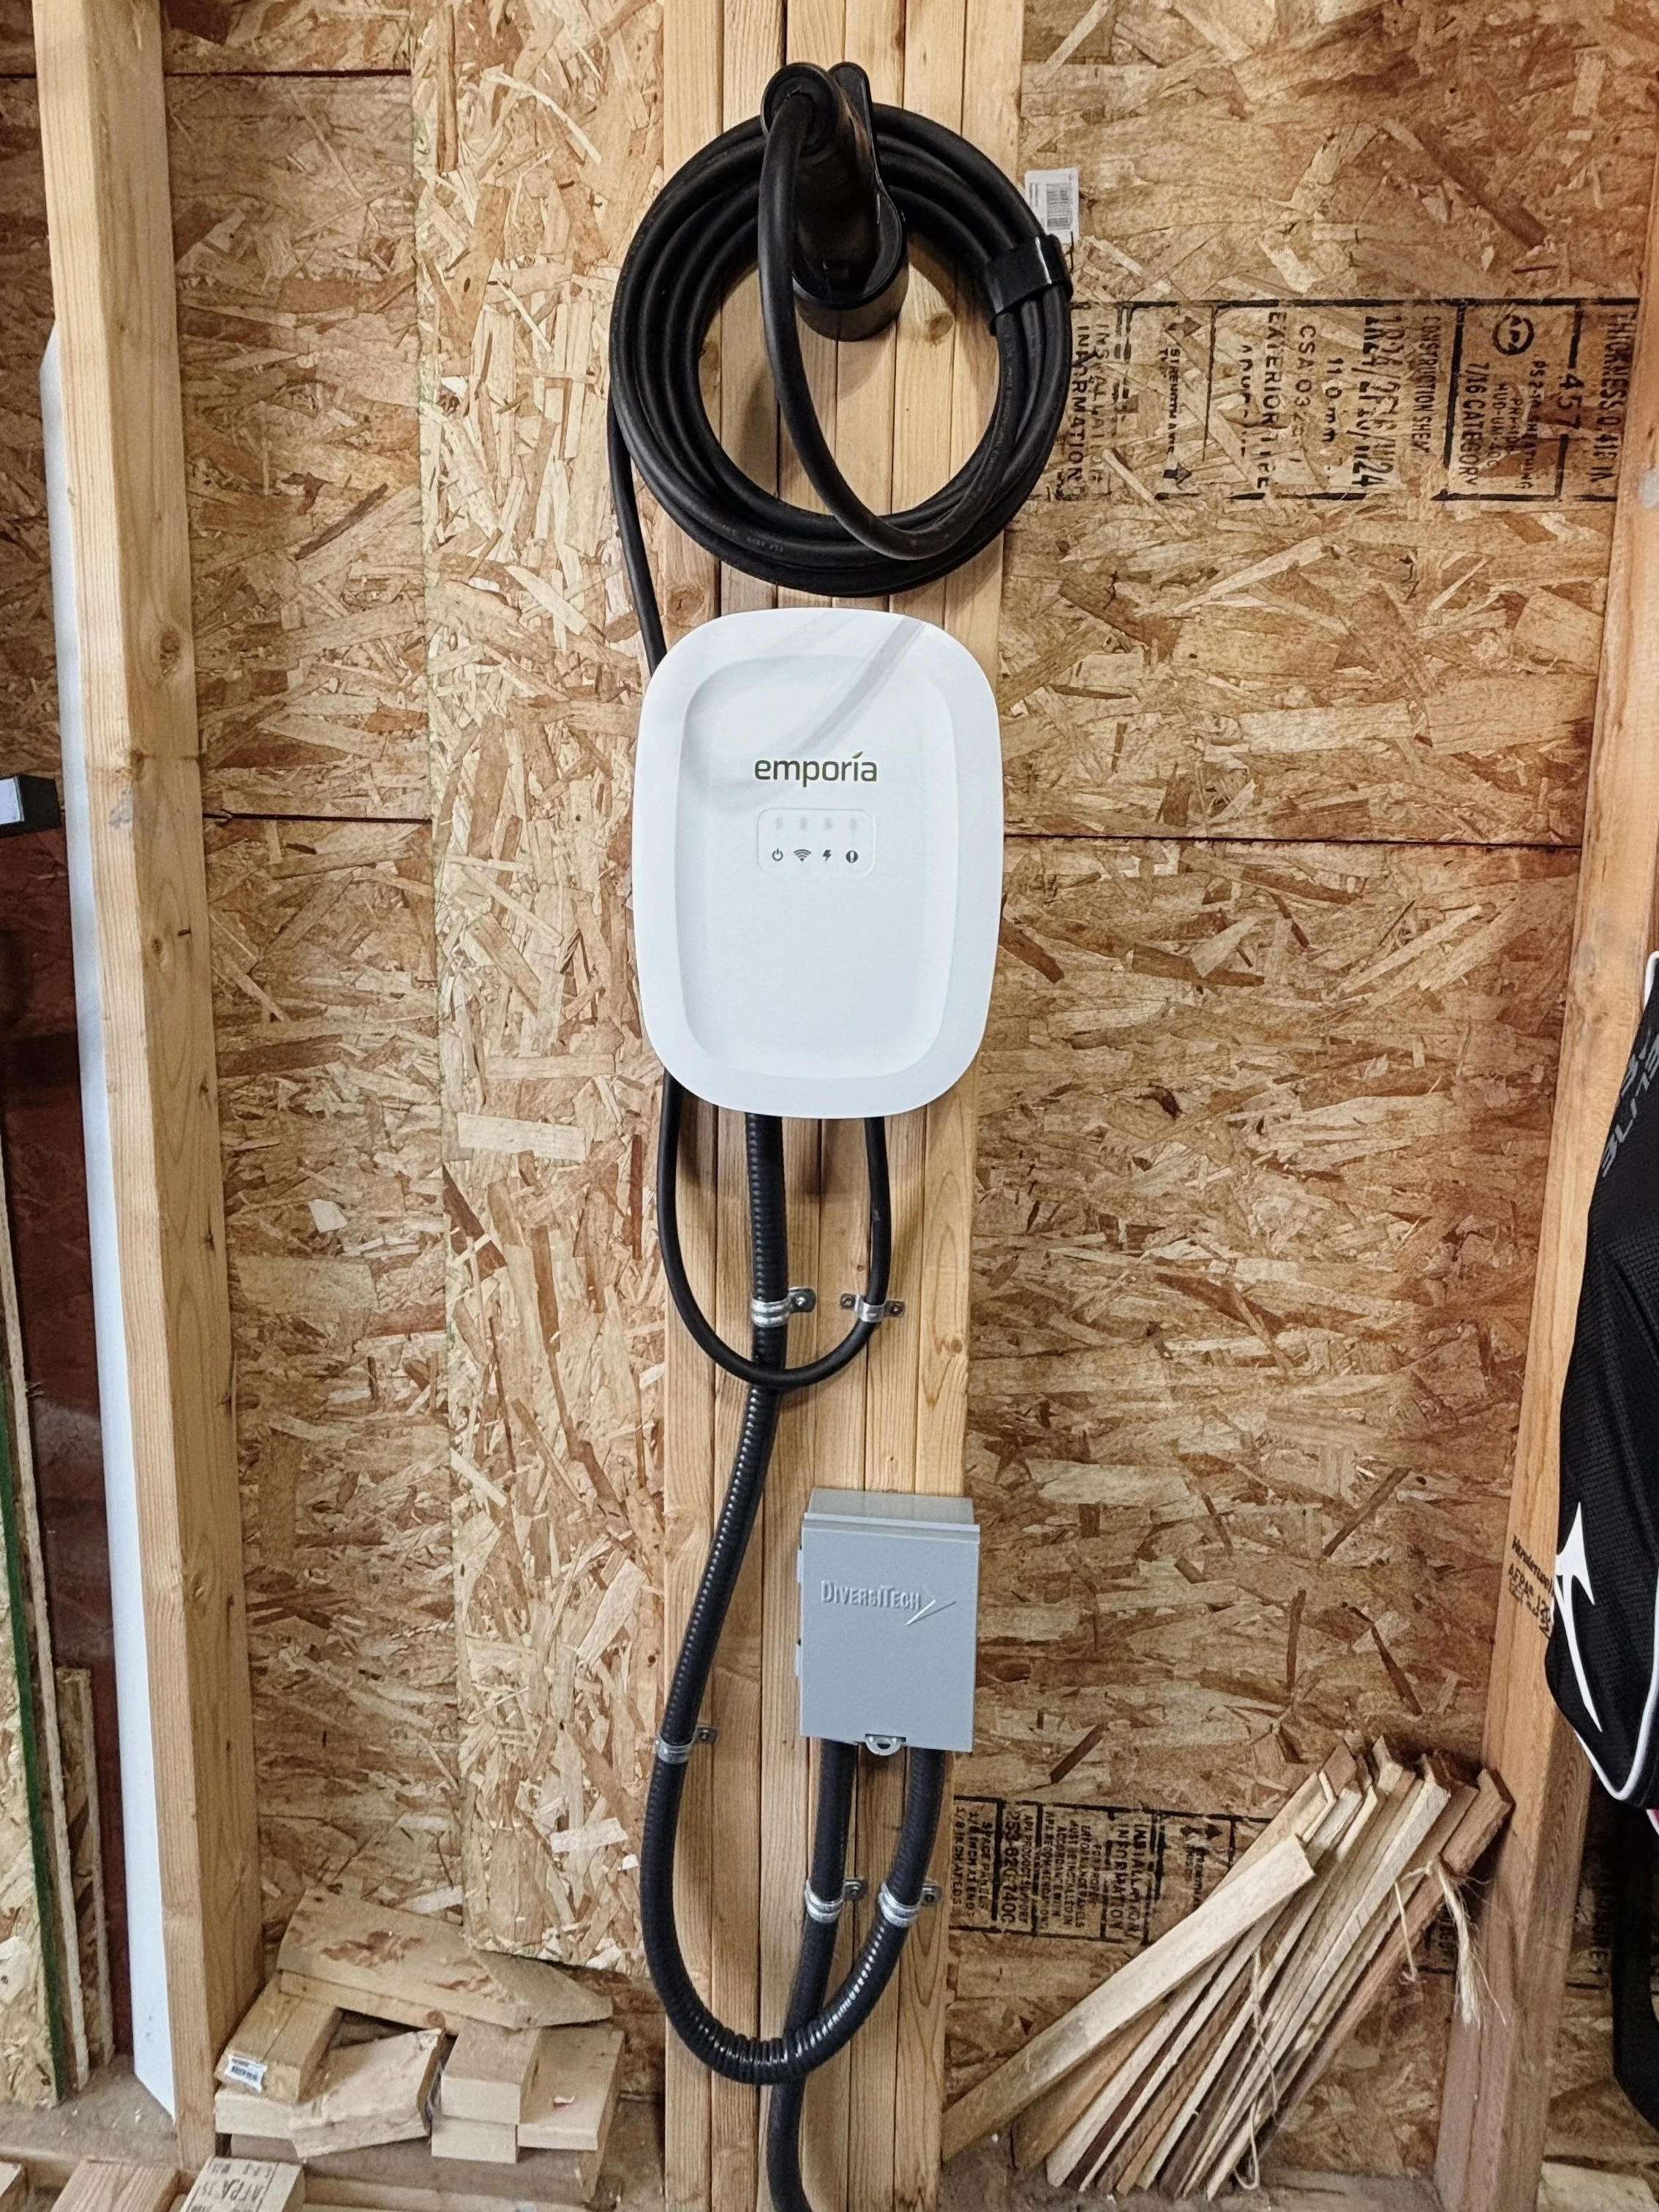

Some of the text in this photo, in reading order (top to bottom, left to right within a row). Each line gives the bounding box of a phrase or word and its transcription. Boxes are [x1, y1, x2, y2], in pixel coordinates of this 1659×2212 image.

[1261, 312, 1287, 426] EXTERIOR
[1297, 325, 1317, 370] CSA
[1413, 316, 1442, 412] CONSTRUCTION
[1459, 363, 1489, 486] 7/16 CATEGORY
